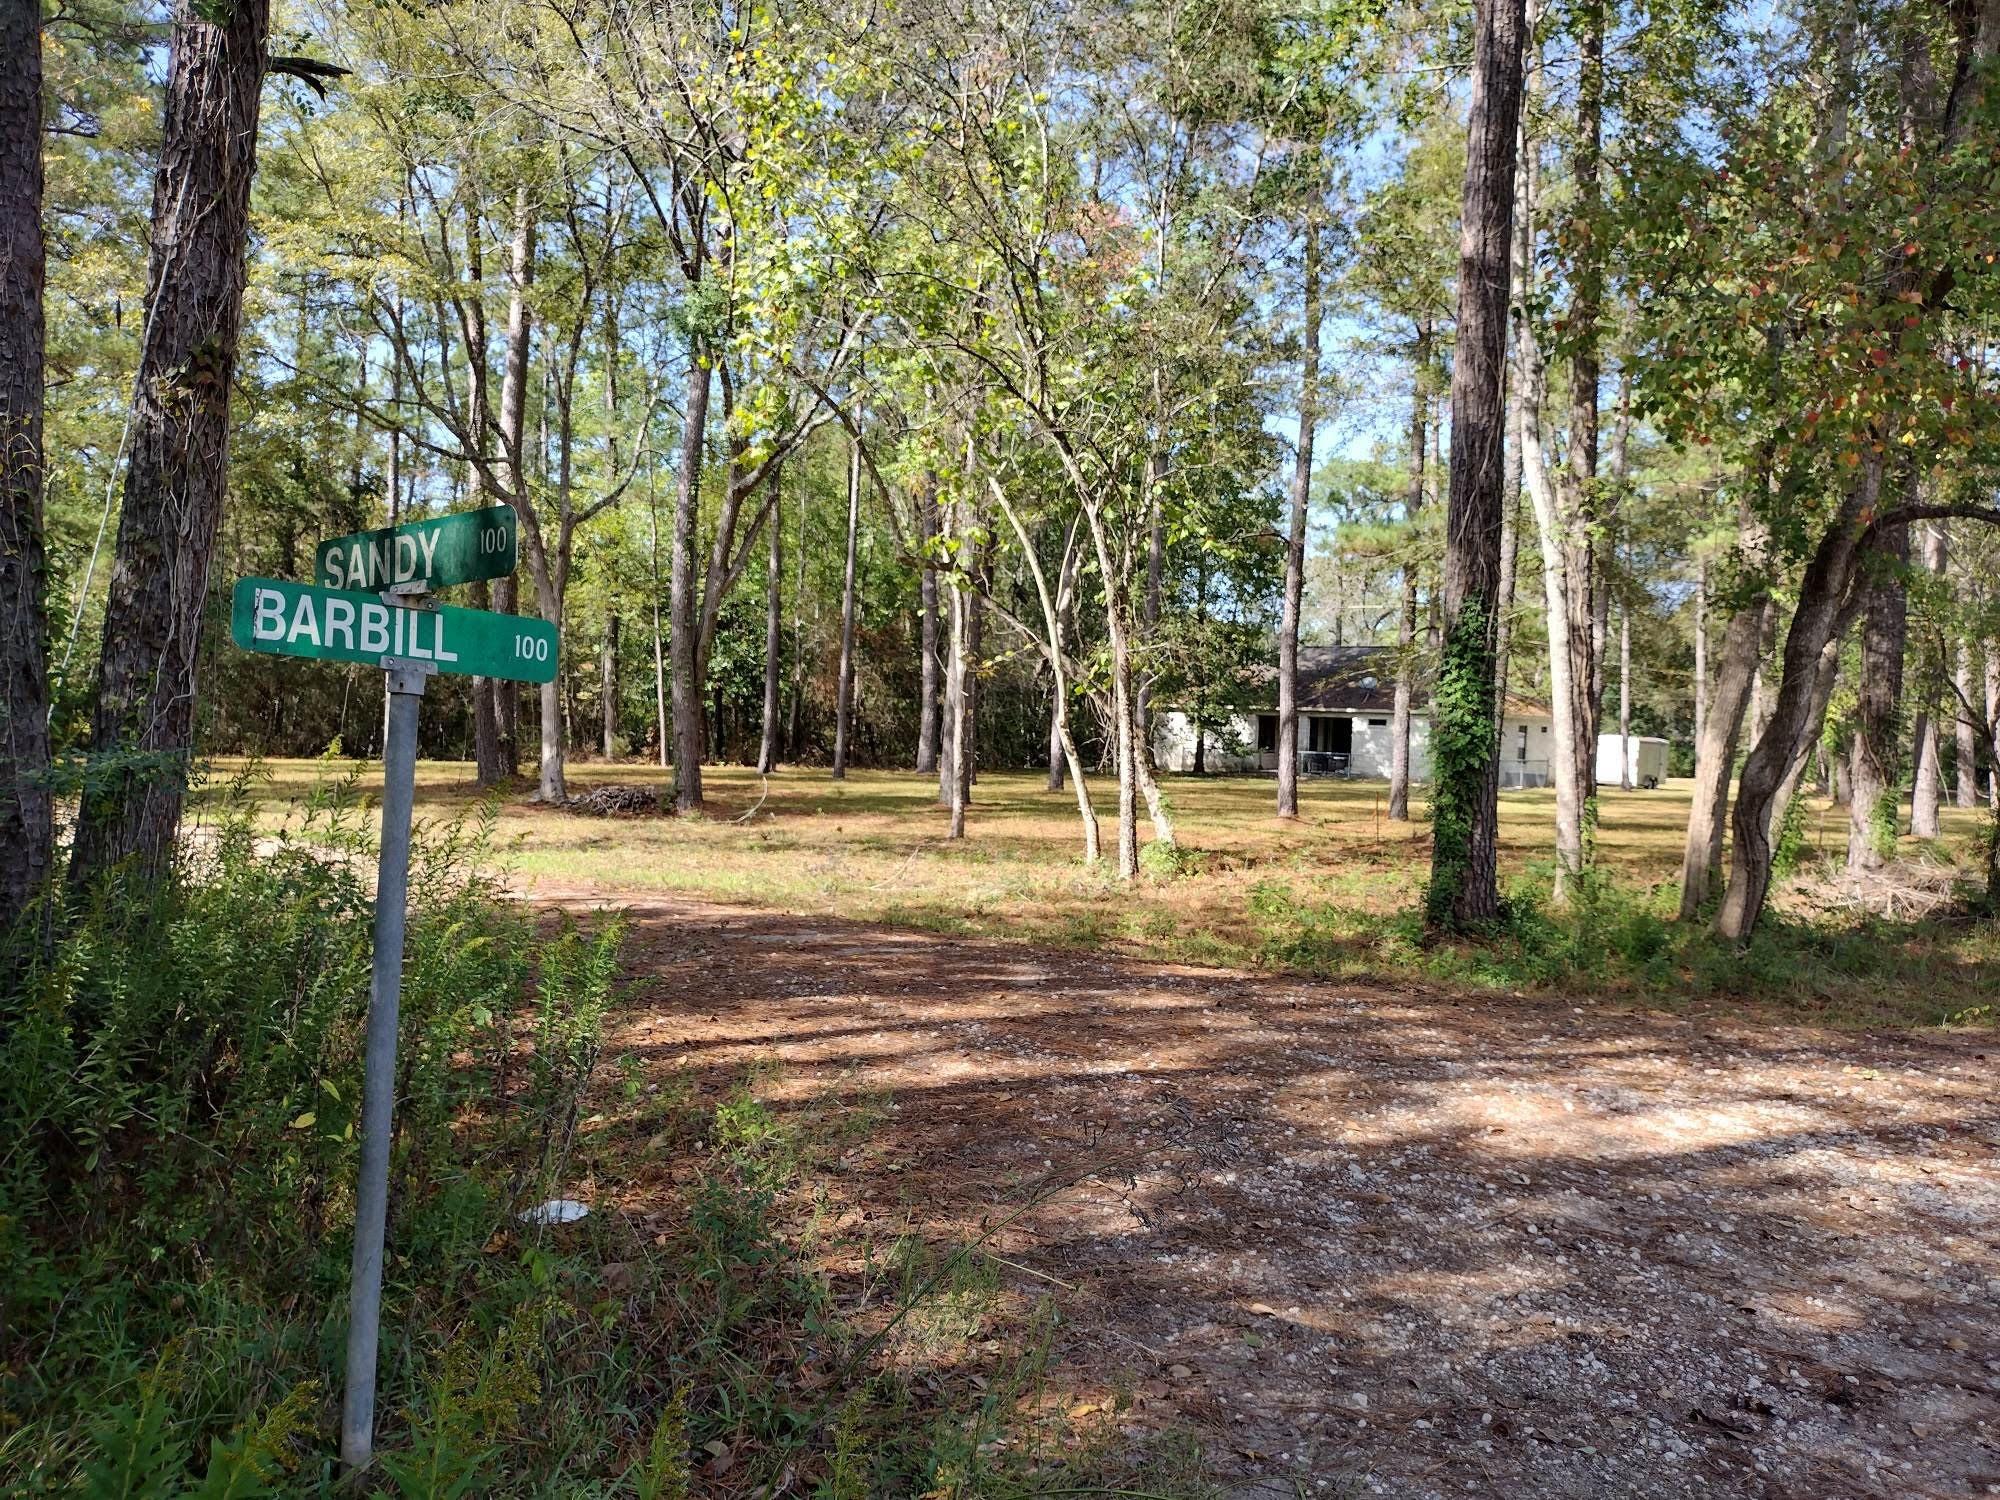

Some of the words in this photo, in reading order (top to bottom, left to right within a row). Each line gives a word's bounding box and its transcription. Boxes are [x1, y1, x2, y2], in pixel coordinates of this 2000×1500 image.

[325, 528, 441, 590] SANDY
[480, 526, 507, 554] 100
[254, 588, 458, 662] BARBILL
[515, 634, 548, 662] 100
